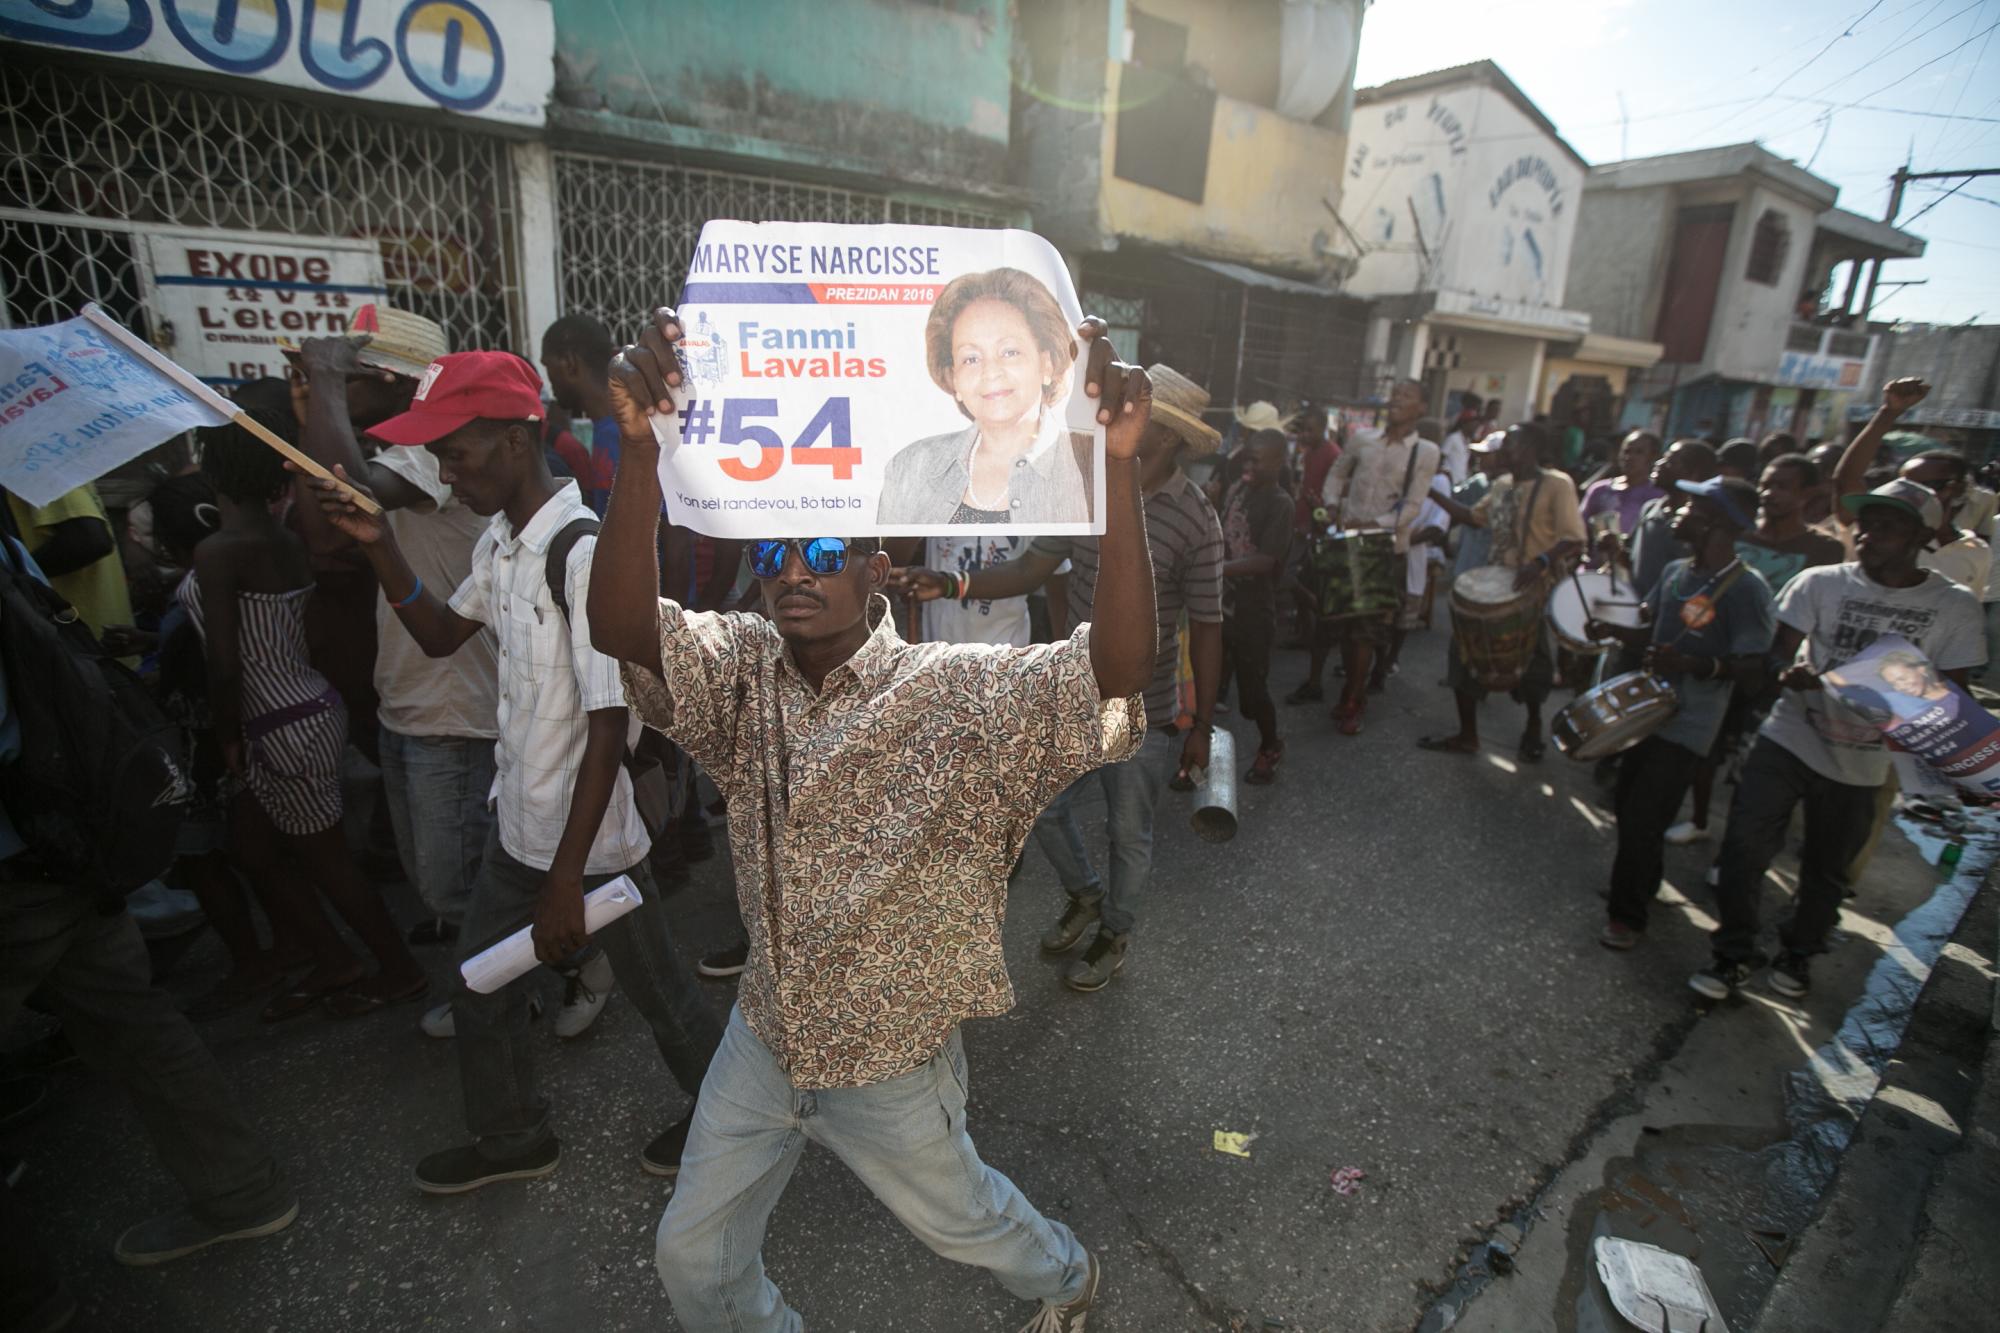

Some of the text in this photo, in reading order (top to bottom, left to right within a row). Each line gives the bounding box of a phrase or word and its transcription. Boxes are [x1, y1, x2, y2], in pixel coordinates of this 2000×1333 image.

[694, 243, 940, 275] MARYSE NARCISSE
[825, 288, 934, 300] PREZIDAN 2016
[196, 306, 348, 332] L'etern
[679, 339, 711, 348] LAVALAS
[738, 321, 856, 350] Fanmi
[740, 351, 887, 378] Lavalas
[678, 396, 862, 481] #54
[724, 496, 798, 511] randevou,
[848, 496, 862, 509] la
